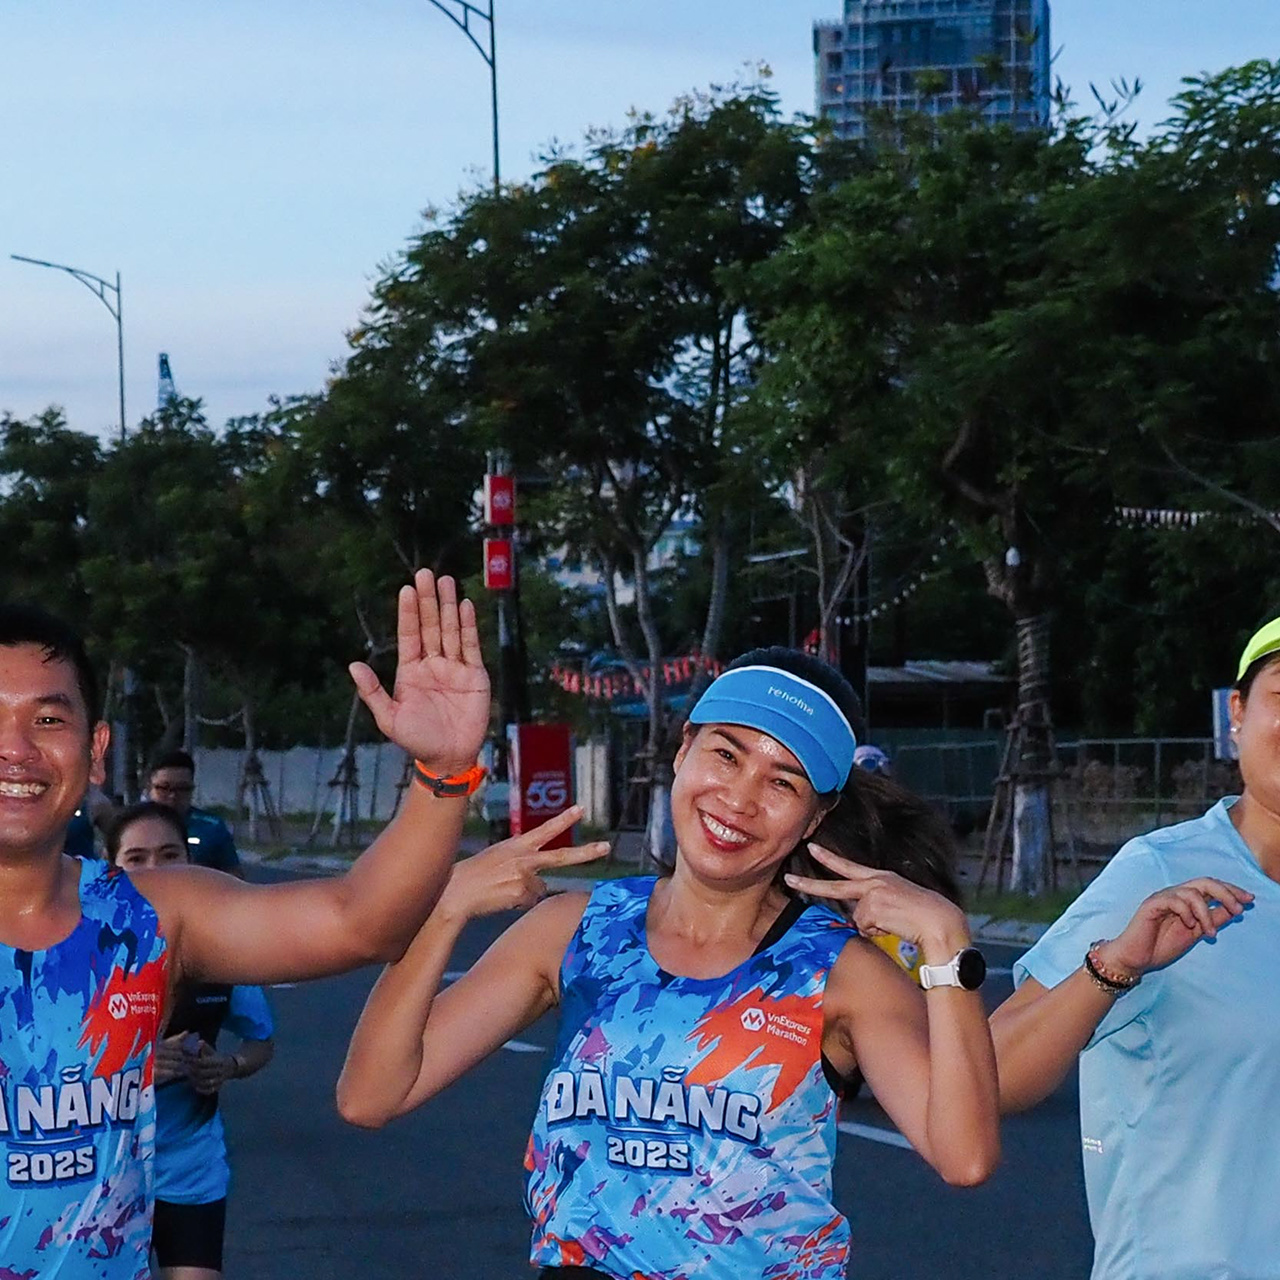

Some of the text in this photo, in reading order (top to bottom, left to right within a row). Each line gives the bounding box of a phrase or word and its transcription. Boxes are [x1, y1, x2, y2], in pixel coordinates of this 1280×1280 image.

[766, 1024, 808, 1046] Marathon
[767, 1012, 812, 1035] VnExpress
[546, 1061, 761, 1141] ĐÀ NẴNG
[7, 1145, 95, 1182] 2025
[606, 1136, 690, 1170] 2025
